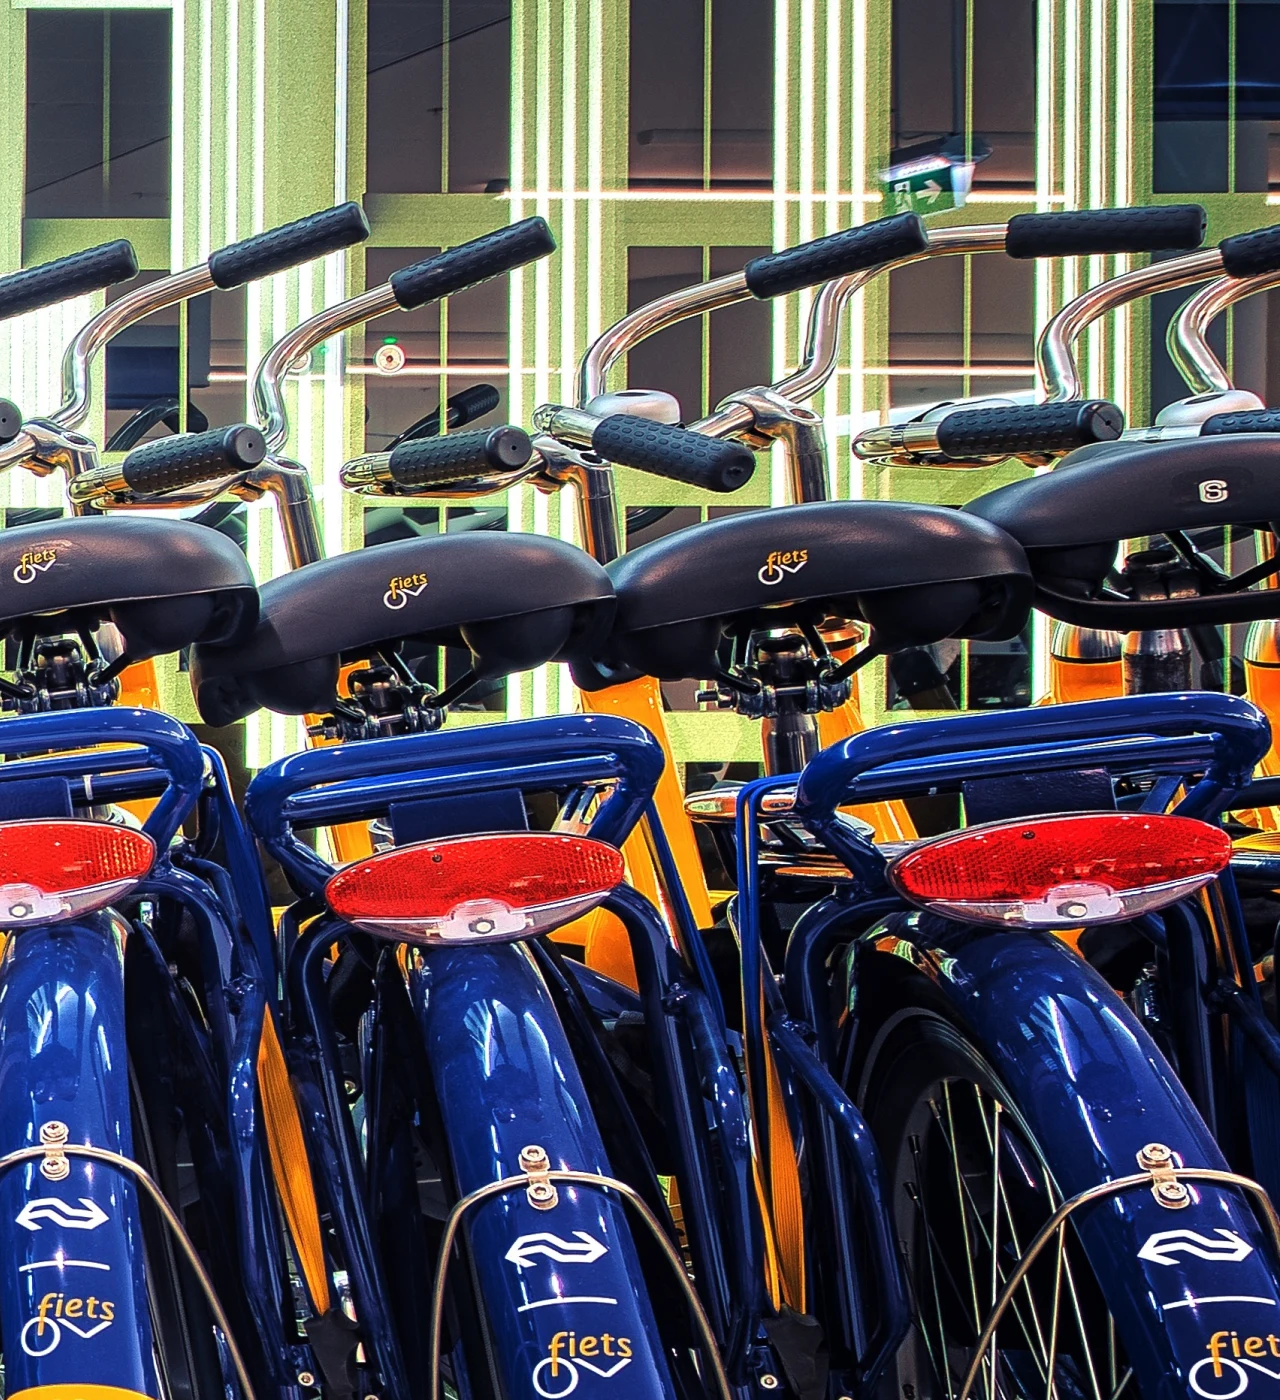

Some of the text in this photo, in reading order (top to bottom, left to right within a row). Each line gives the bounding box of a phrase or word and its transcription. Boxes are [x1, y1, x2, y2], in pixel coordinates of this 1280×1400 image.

[20, 549, 56, 575] fiets
[766, 549, 808, 576] fiets
[389, 573, 428, 600] fiets
[37, 1292, 115, 1337] fiets
[547, 1331, 633, 1378] fiets
